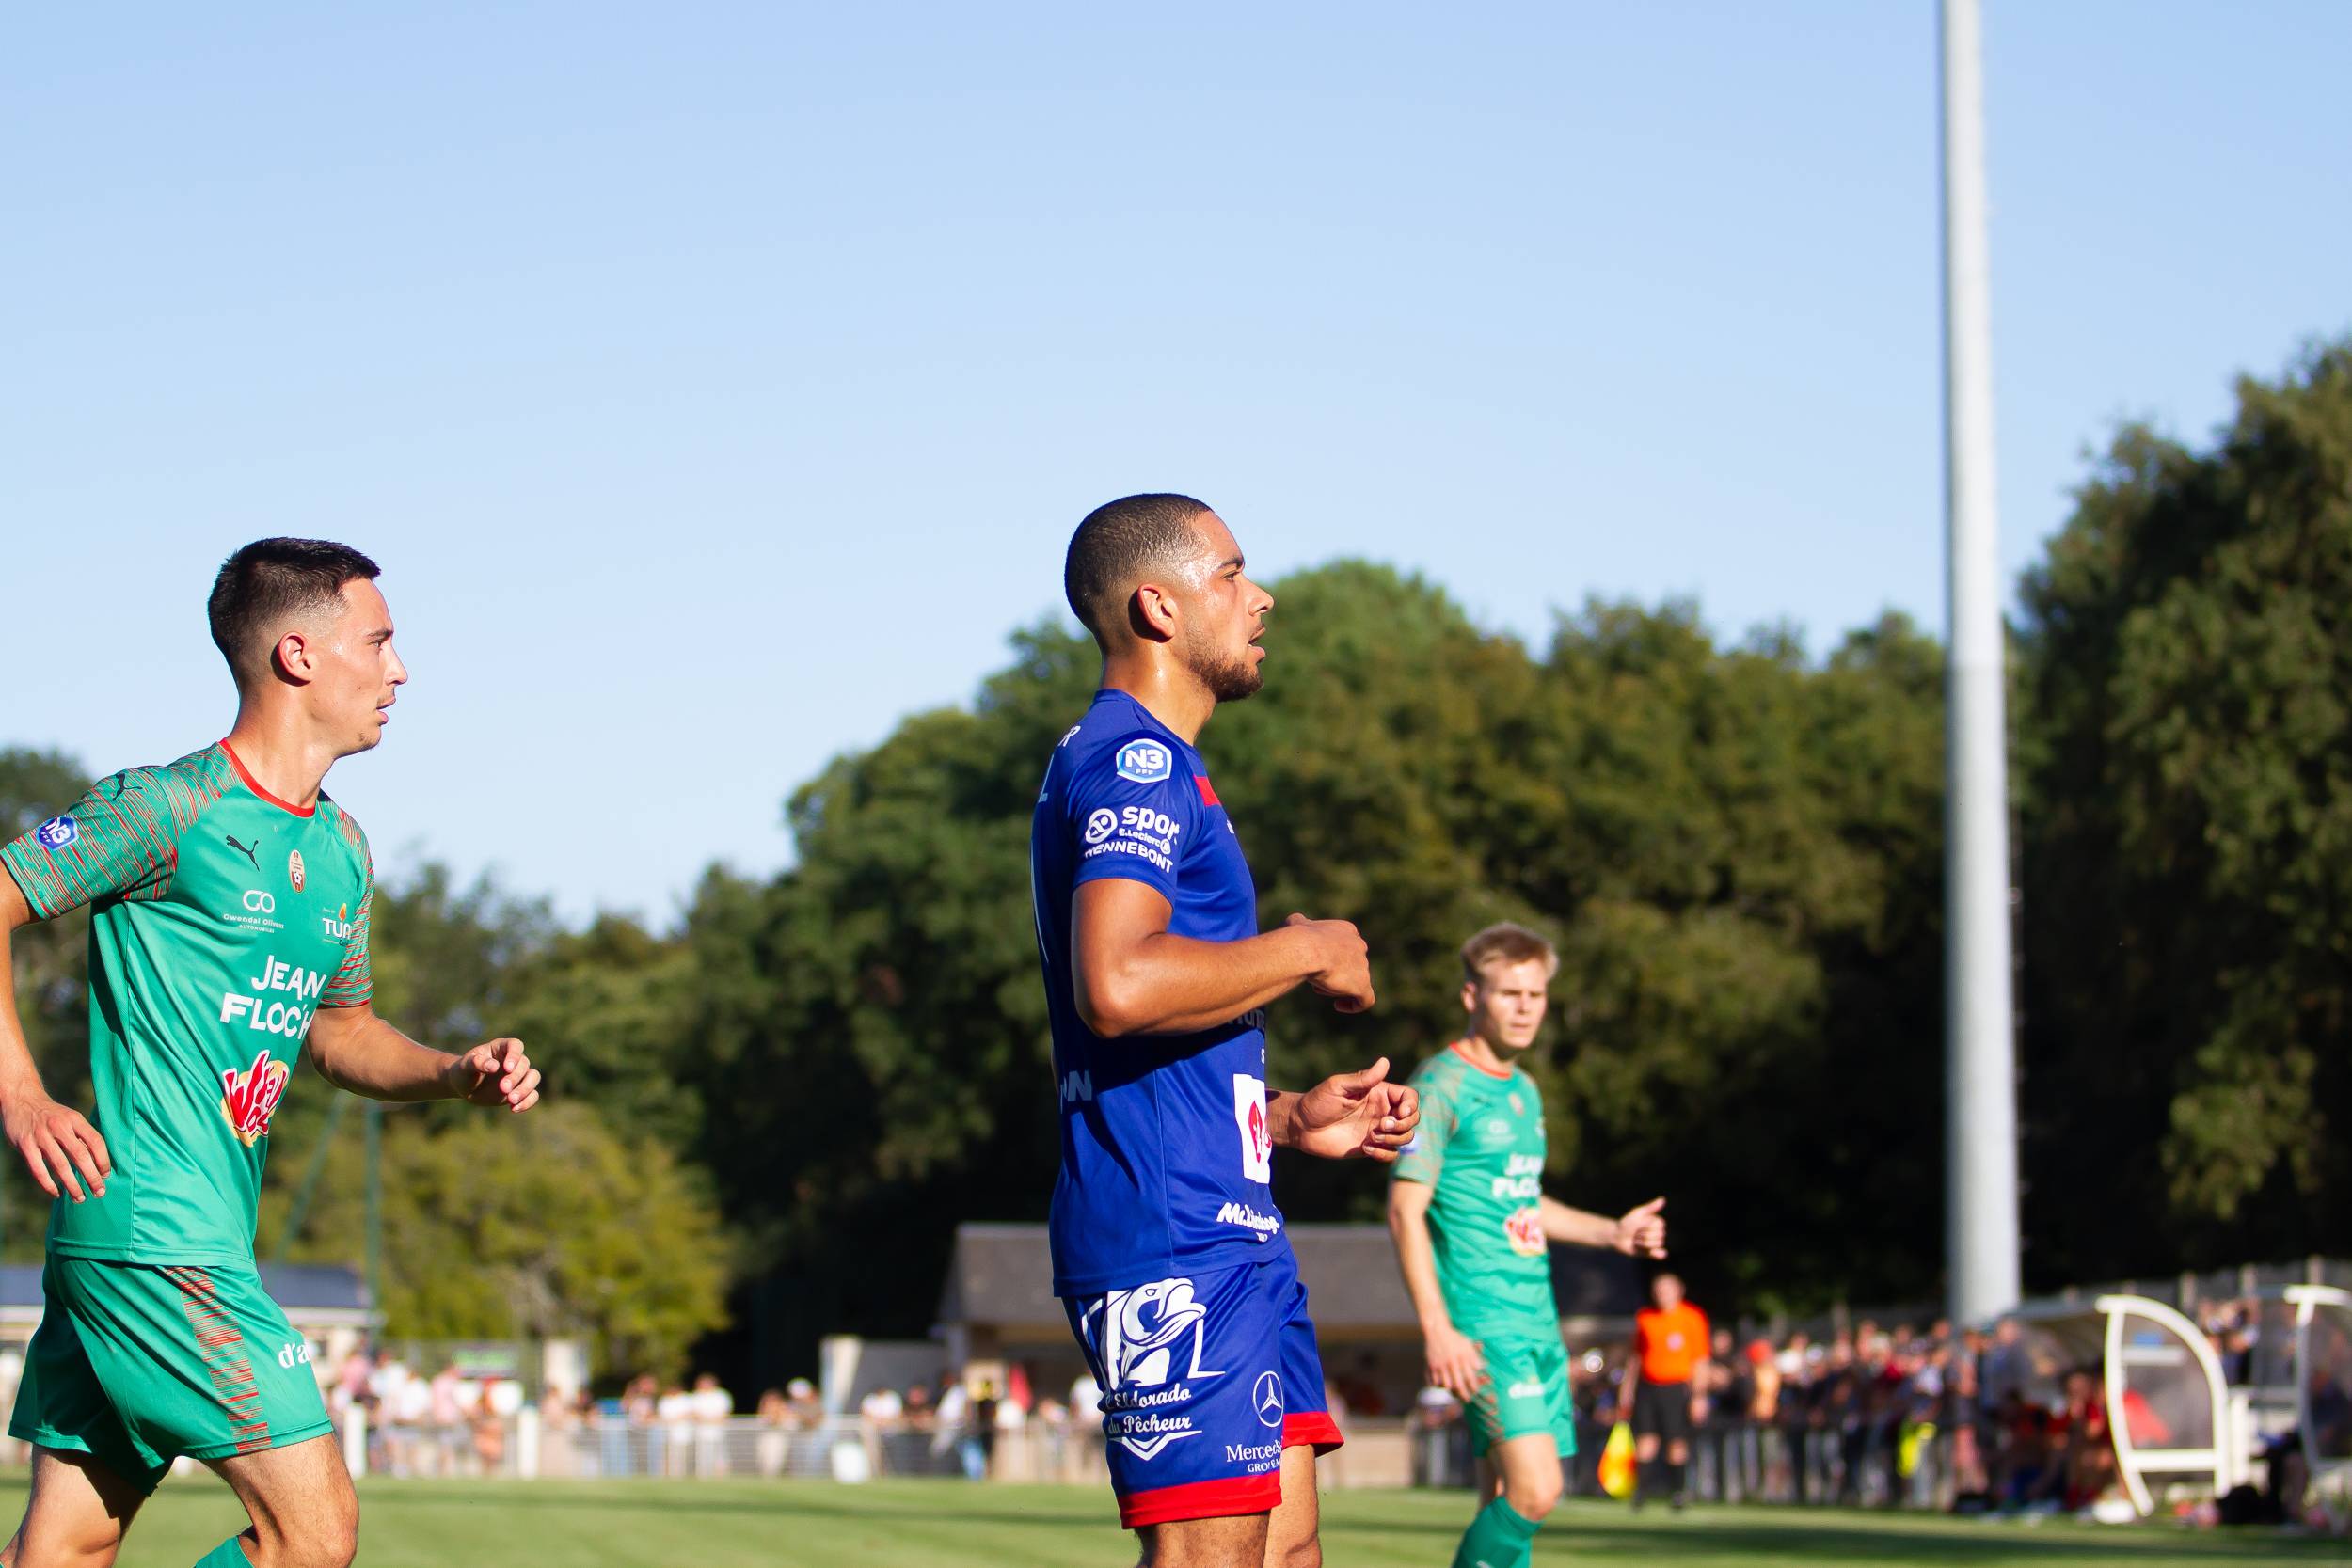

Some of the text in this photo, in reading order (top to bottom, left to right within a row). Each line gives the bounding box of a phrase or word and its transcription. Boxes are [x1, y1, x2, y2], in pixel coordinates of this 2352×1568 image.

[1125, 748, 1164, 769] N3
[251, 954, 327, 1002] JEAN
[219, 991, 317, 1040] FLOC'H
[1123, 1413, 1192, 1433] Pêcheur
